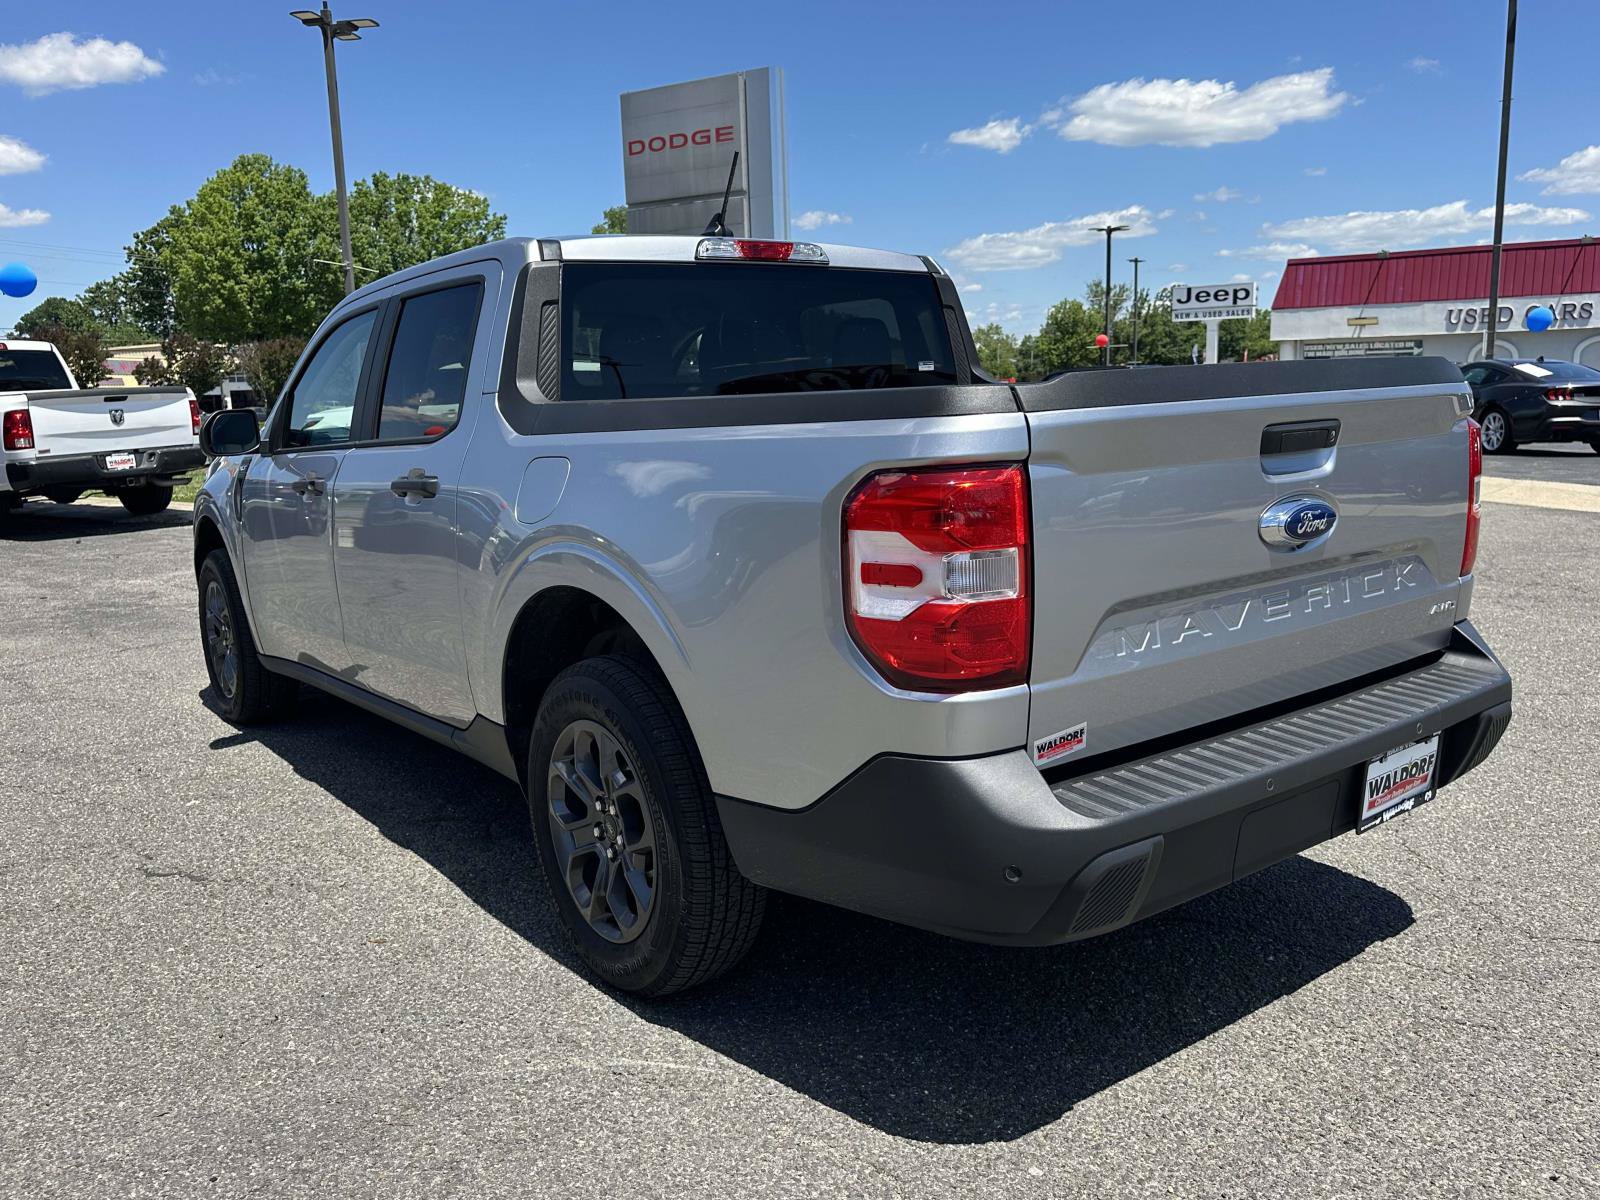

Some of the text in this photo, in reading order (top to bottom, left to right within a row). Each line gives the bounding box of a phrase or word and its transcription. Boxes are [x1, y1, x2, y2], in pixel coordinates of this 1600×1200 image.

[628, 126, 734, 156] DODGE
[1176, 287, 1250, 305] Jeep
[1174, 312, 1191, 320] NEW
[1202, 311, 1222, 319] USED
[1225, 309, 1251, 317] SALES
[1447, 306, 1514, 324] USED
[1297, 510, 1328, 534] Ford
[1116, 561, 1417, 657] MAVERICK
[1036, 728, 1085, 753] WALDORF
[1368, 753, 1434, 798] WALDORF
